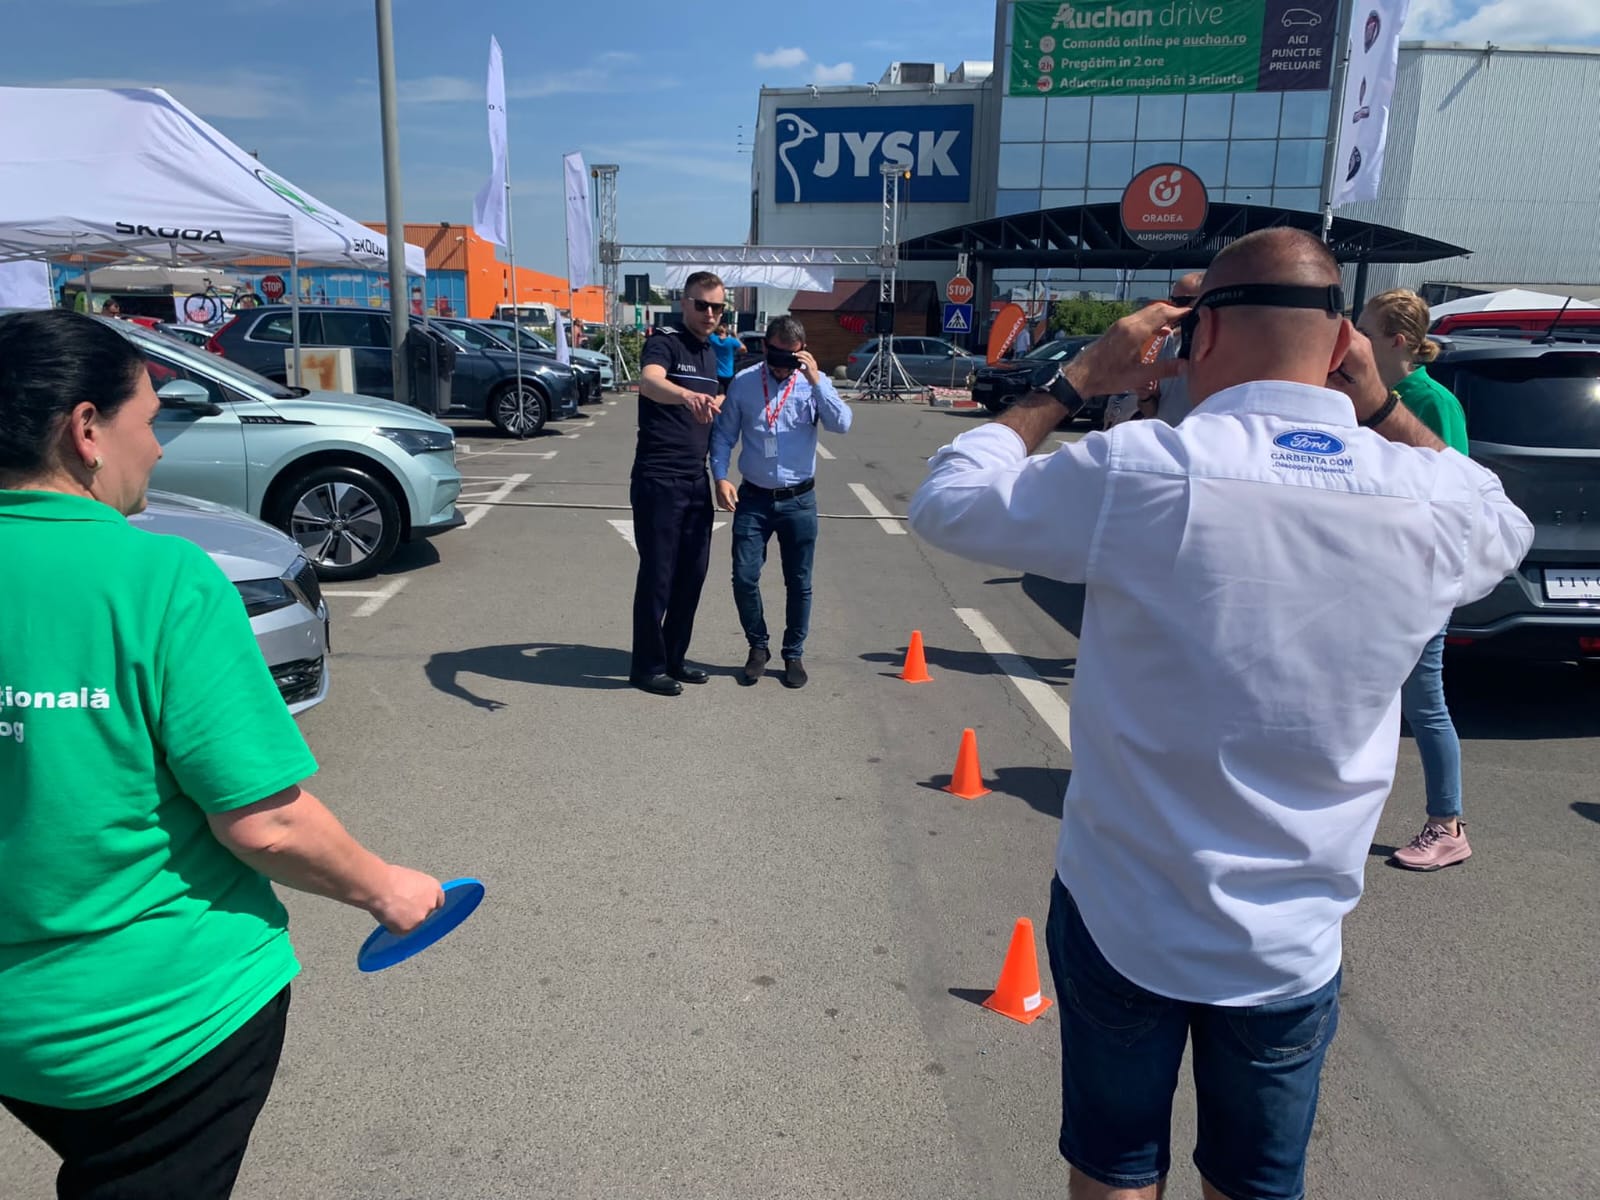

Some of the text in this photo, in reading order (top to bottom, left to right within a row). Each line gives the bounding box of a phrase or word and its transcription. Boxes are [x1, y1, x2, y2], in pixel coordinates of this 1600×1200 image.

[1052, 1, 1223, 29] Auchan drive
[1062, 37, 1121, 49] Comandă
[1123, 36, 1162, 48] online
[1165, 39, 1180, 49] pe
[1183, 33, 1247, 47] auchan.ro
[1287, 35, 1309, 45] AICI
[1271, 48, 1322, 58] PUNCT DE
[1061, 55, 1116, 72] Pregătim
[1134, 56, 1142, 67] 2
[1144, 57, 1164, 67] ore
[1269, 60, 1321, 71] PRELUARE
[1060, 77, 1109, 89] Aducem
[1111, 76, 1124, 88] la
[1188, 75, 1196, 85] 3
[1199, 74, 1244, 86] minute
[813, 130, 961, 178] JYSK
[1142, 214, 1184, 223] ORADEA
[1137, 233, 1189, 241] AUSHOPPING
[262, 280, 283, 292] STOP
[949, 285, 971, 296] STOP
[1290, 434, 1332, 451] Ford
[1271, 453, 1353, 467] CARBENTA COM
